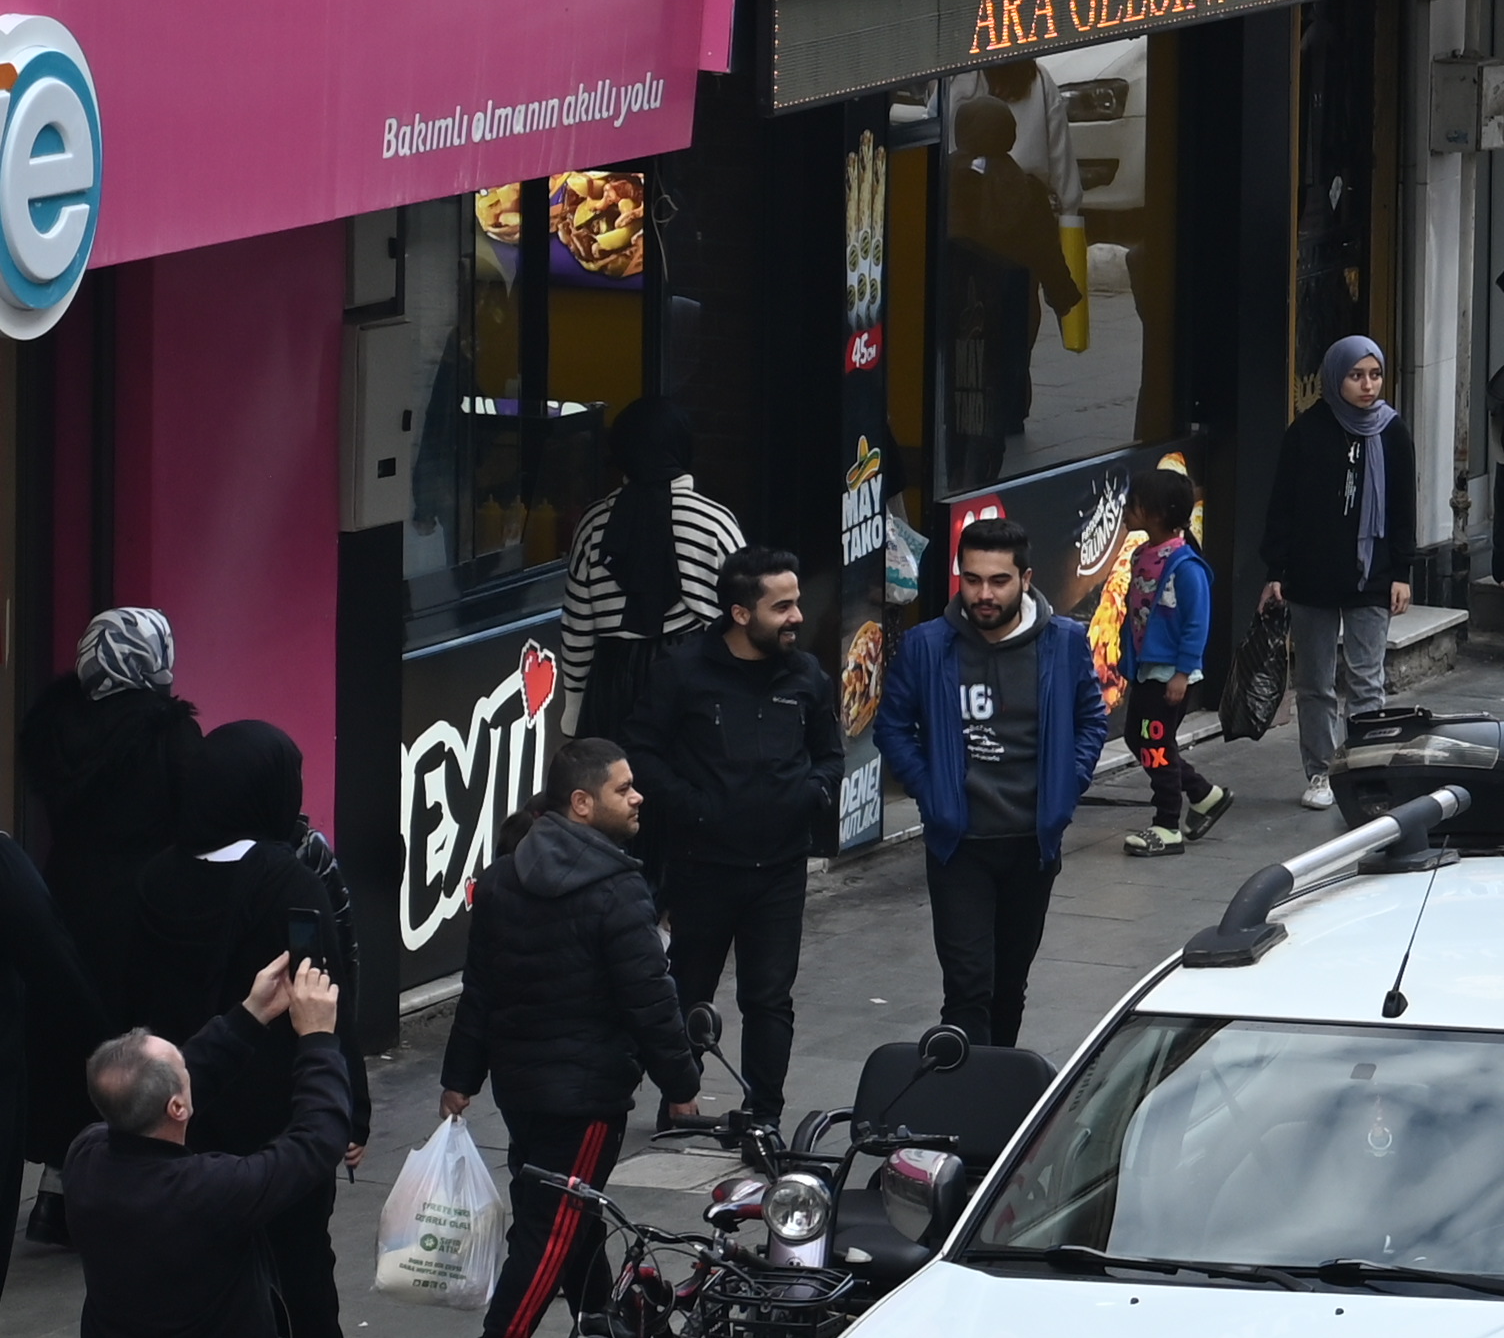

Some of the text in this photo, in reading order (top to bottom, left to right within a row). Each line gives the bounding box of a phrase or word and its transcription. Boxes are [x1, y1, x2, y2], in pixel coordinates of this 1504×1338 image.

[382, 71, 664, 159] Bakımlı olmanın akıllı yolu
[841, 473, 883, 531] MAY
[841, 515, 884, 567] TAKO
